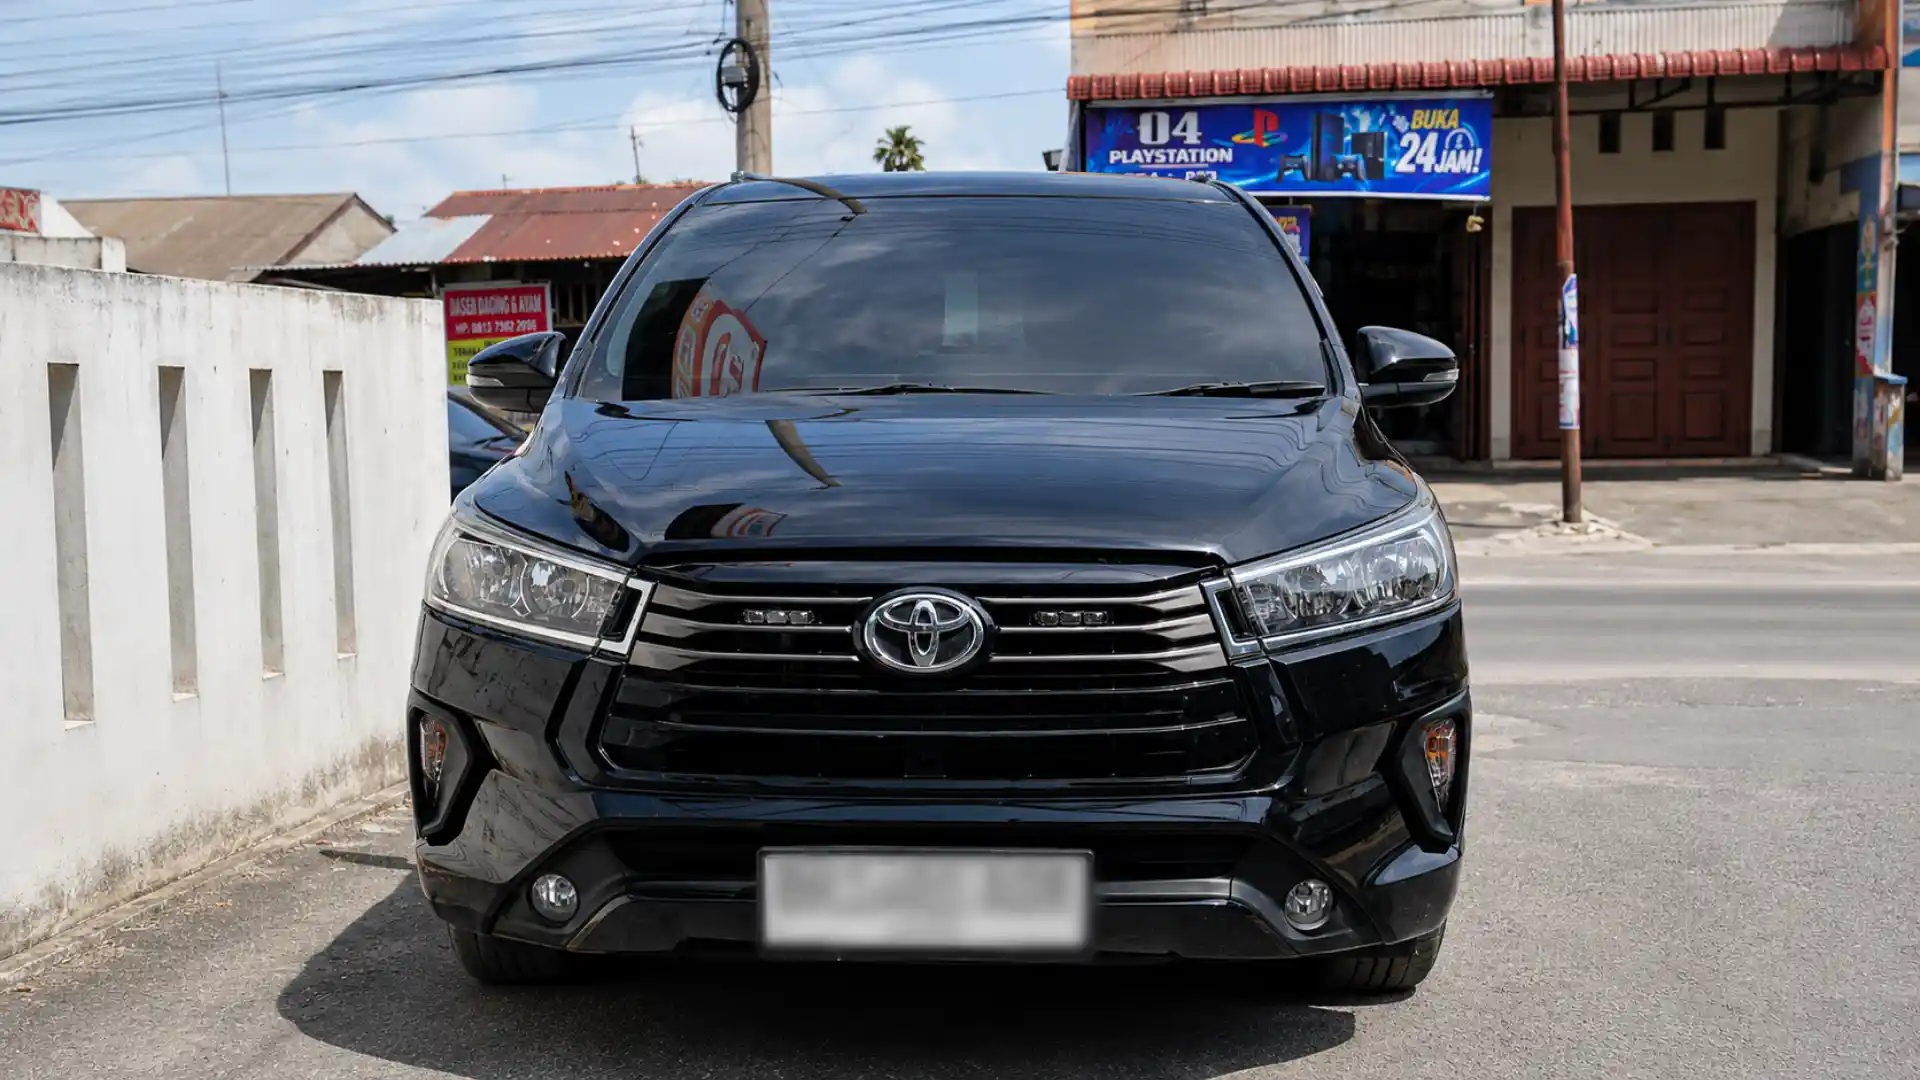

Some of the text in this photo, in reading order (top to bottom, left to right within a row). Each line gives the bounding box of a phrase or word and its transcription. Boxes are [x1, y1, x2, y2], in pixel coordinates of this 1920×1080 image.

[1139, 111, 1202, 145] 04
[1411, 108, 1459, 129] BUKA
[1109, 147, 1233, 164] PLAYSTATION
[1395, 131, 1483, 174] 24 JAM!
[519, 294, 542, 313] AYAM
